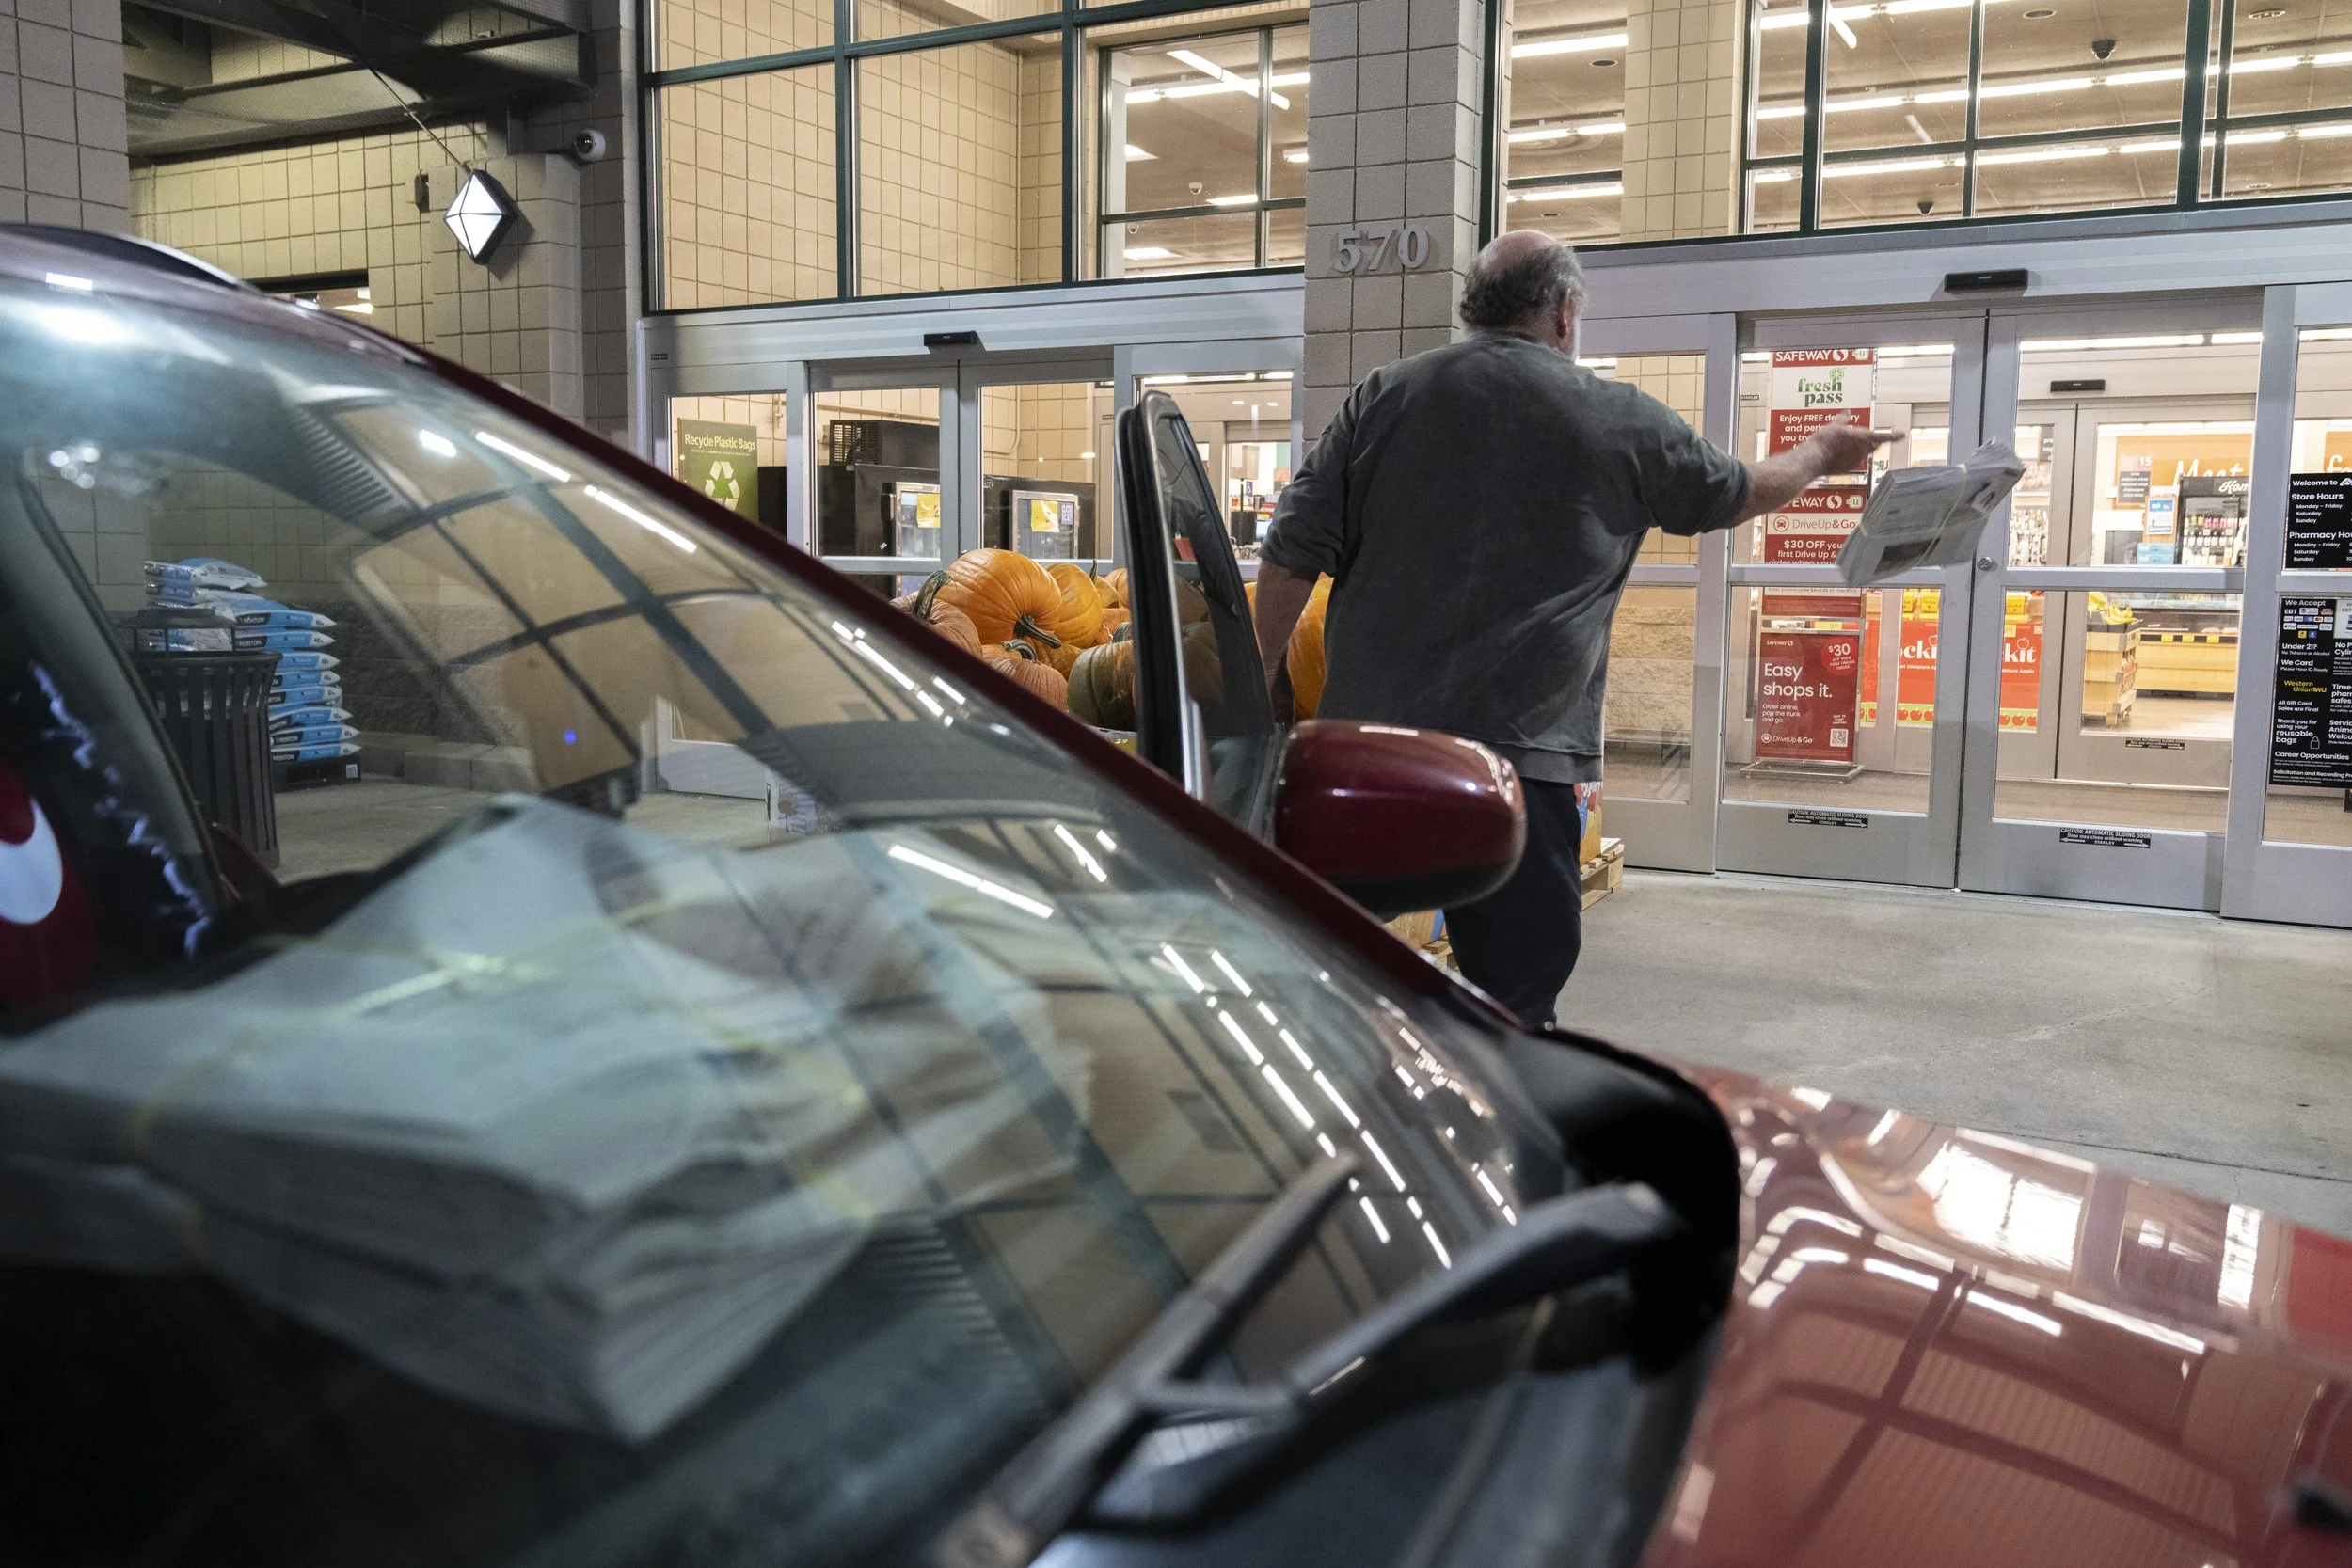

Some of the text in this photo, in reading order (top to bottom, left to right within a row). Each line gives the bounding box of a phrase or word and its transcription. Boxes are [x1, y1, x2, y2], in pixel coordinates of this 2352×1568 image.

[1333, 225, 1429, 273] 570
[1775, 349, 1831, 362] SAFEWAY
[1798, 377, 1843, 392] fresh
[1804, 393, 1843, 407] pass
[1780, 415, 1803, 424] Enjoy
[1804, 414, 1823, 422] FREE
[685, 434, 756, 451] Recycle Plastic Bags
[1780, 436, 1799, 444] you
[2289, 531, 2336, 540] Pharmacy
[1784, 540, 1804, 549] $30
[1805, 540, 1825, 549] OFF
[1818, 550, 1829, 560] Up
[1828, 643, 1851, 657] $30
[1764, 662, 1803, 682] Easy
[1763, 681, 1833, 701] shops it.
[2276, 736, 2297, 745] bags
